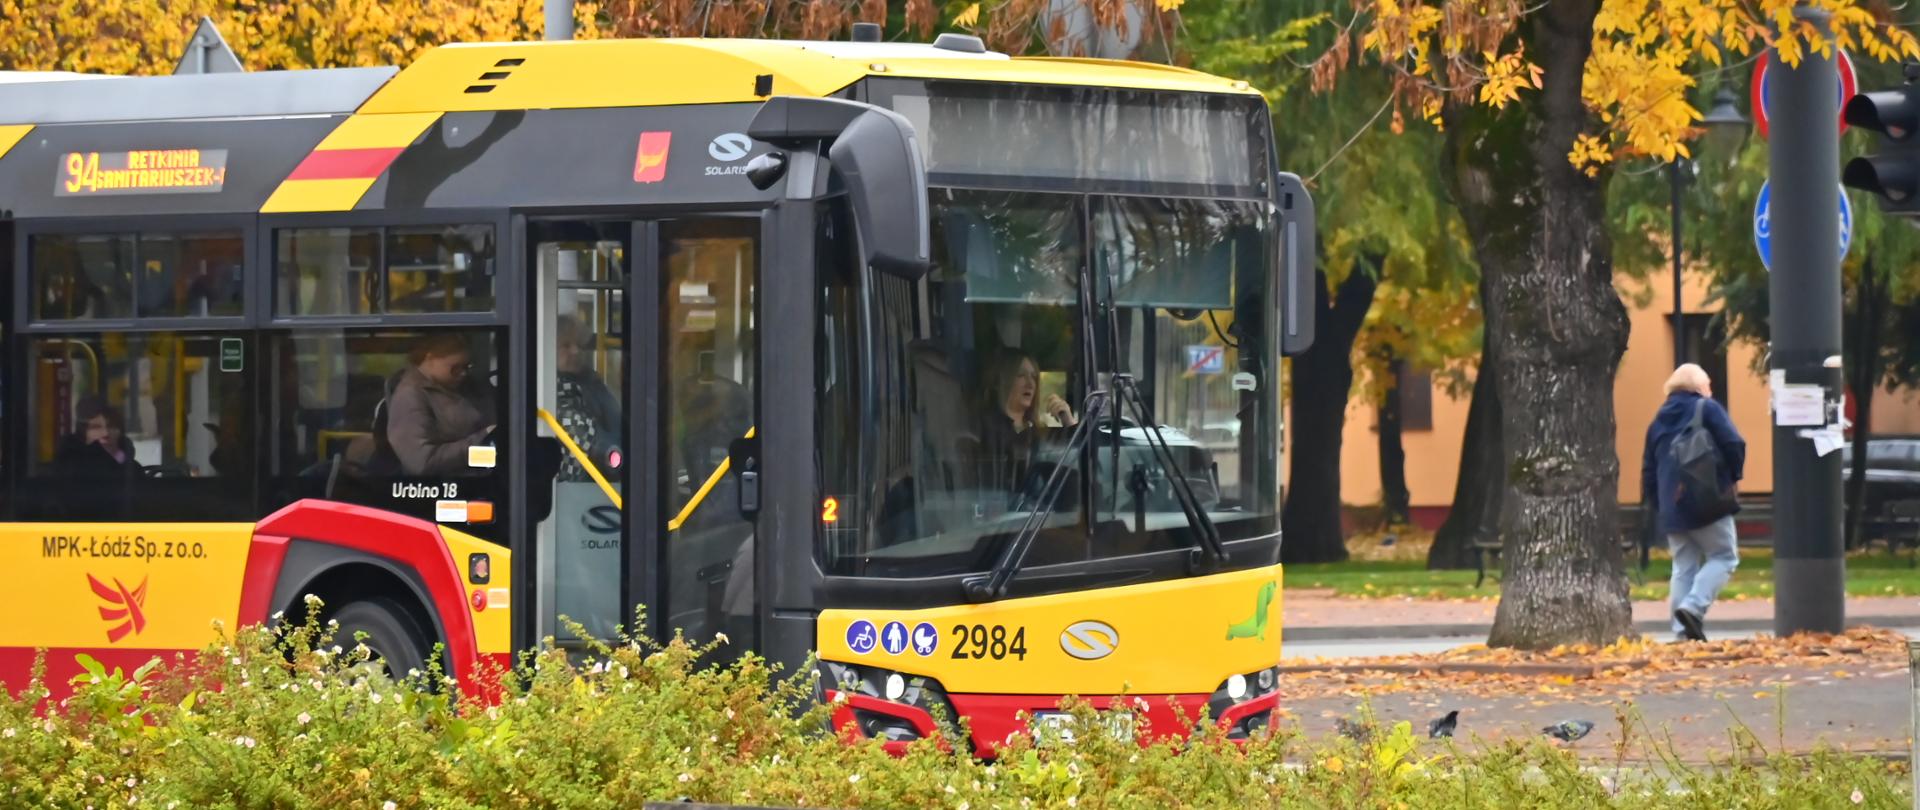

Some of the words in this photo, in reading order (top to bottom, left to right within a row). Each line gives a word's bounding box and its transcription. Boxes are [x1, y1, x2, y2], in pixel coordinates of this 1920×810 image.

[128, 149, 200, 169] RETKINIA
[704, 165, 748, 176] SOLARIS
[65, 151, 100, 193] 94
[392, 482, 440, 498] Urbino
[442, 482, 458, 498] 18
[822, 497, 838, 521] 2
[42, 535, 132, 558] MPK-Łódź
[134, 535, 162, 563] Sp.
[164, 541, 174, 558] z
[176, 541, 208, 559] o.o.
[951, 624, 1028, 662] 2984
